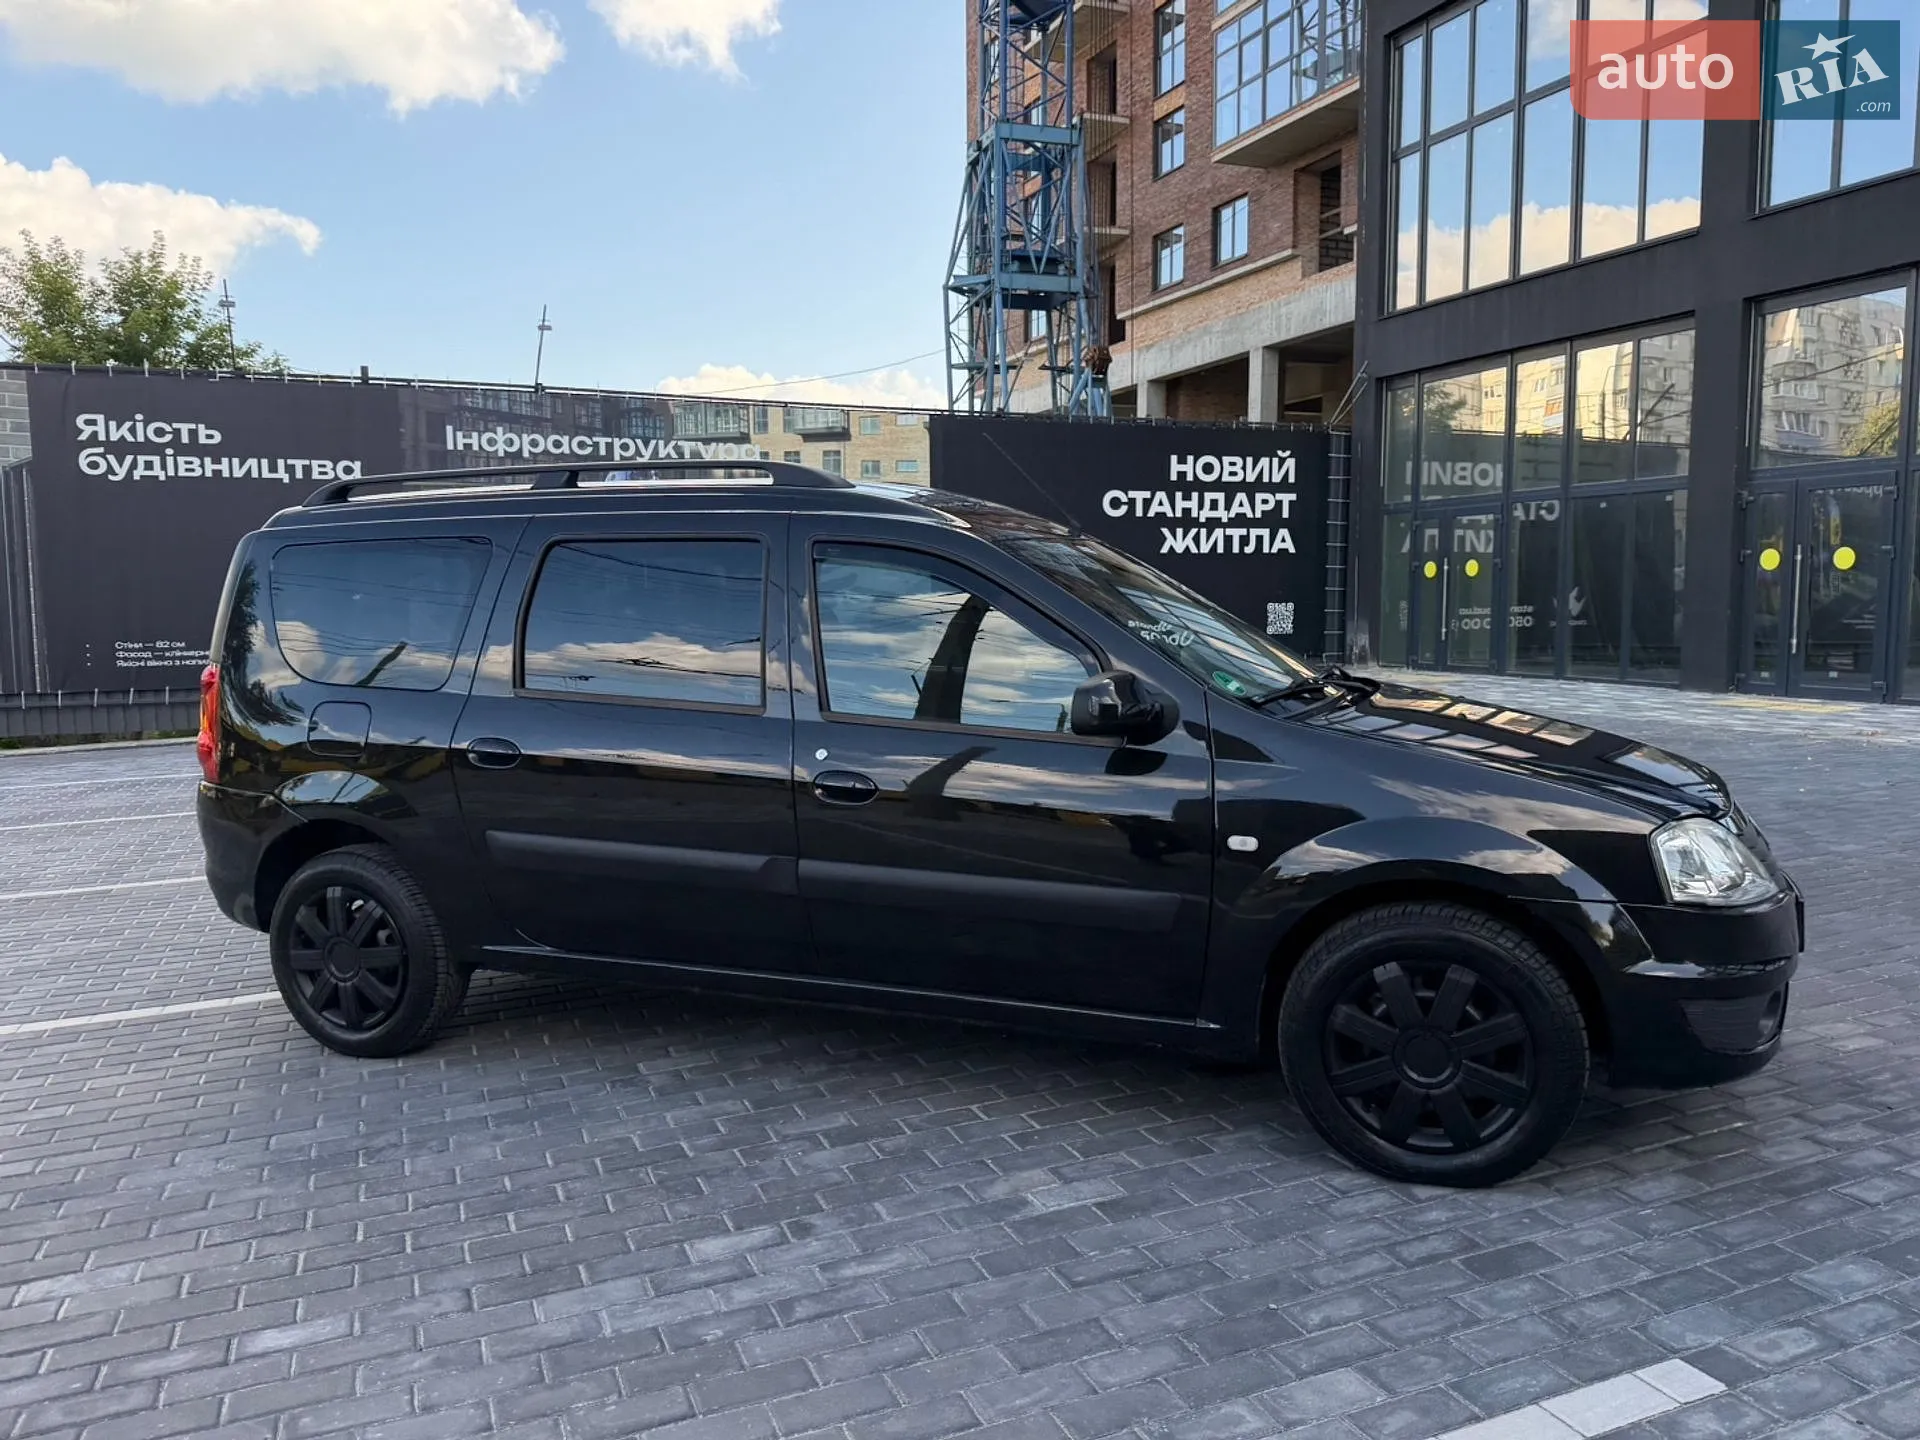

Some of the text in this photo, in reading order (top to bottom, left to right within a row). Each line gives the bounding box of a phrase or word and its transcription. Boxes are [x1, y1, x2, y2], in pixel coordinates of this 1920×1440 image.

[75, 413, 222, 445] Якість
[445, 425, 761, 461] Інфраструктура
[78, 448, 363, 484] будівництва
[1170, 450, 1296, 484] НОВИЙ
[1102, 490, 1297, 523] СТАНДАРТ
[1160, 528, 1296, 554] ЖИТЛА
